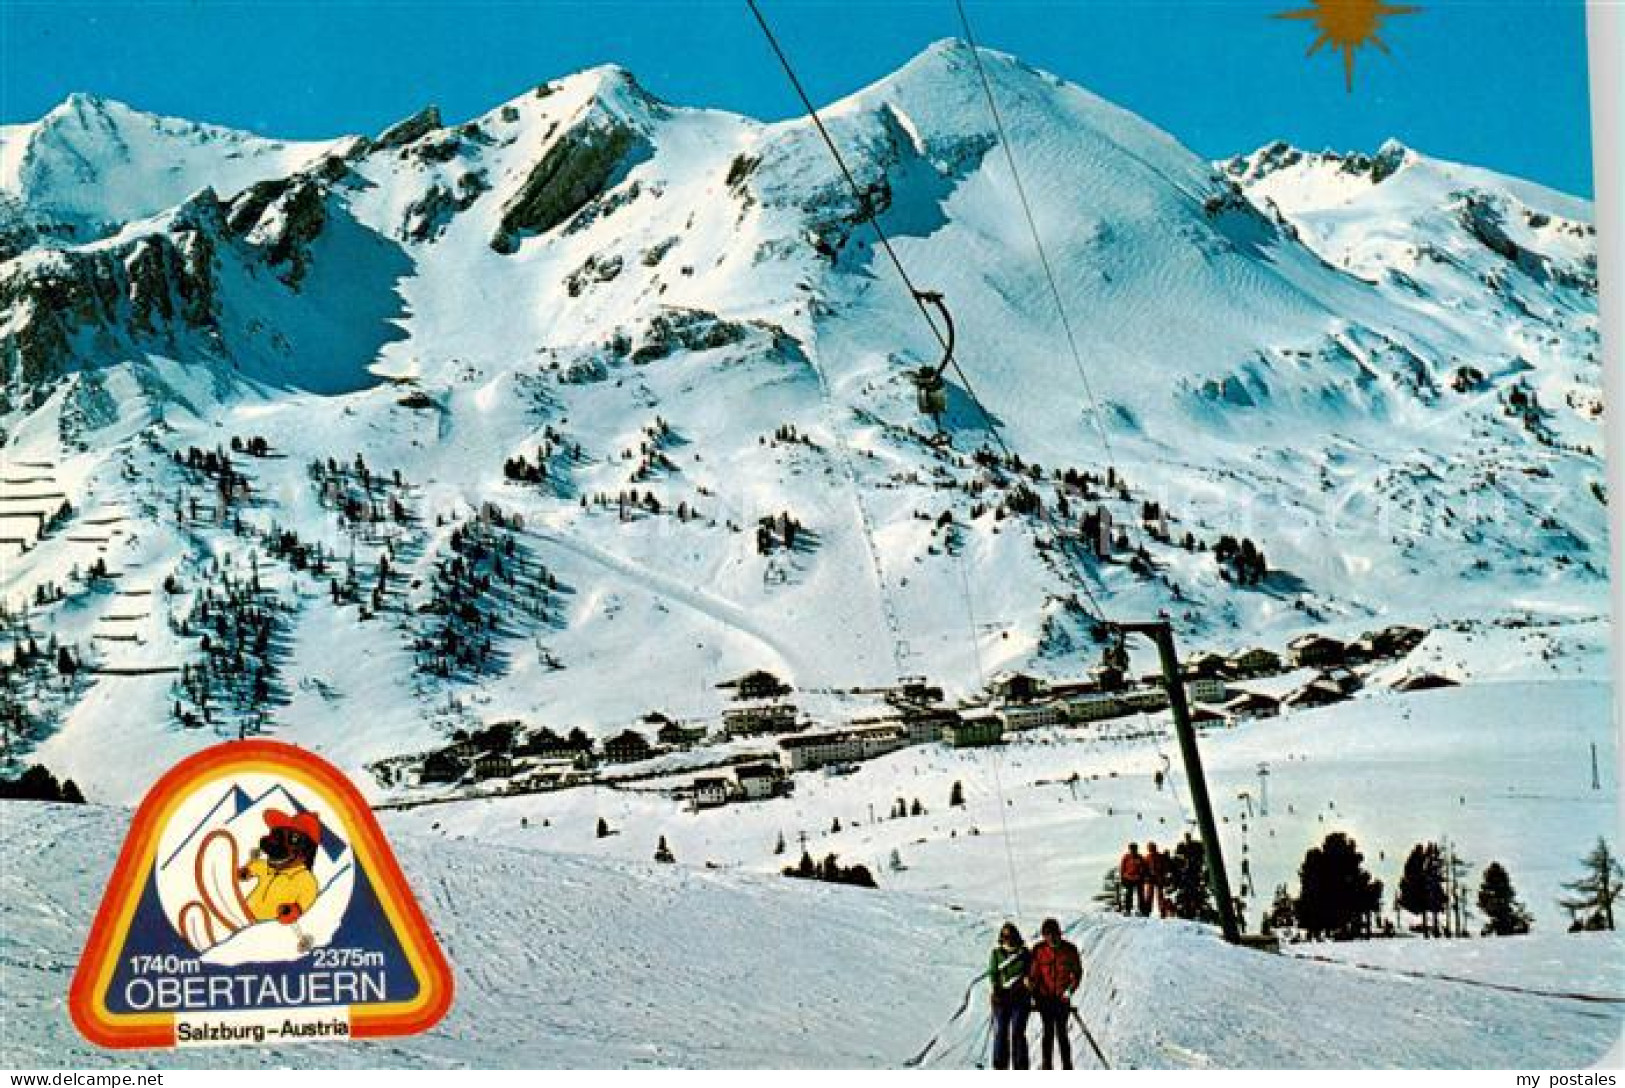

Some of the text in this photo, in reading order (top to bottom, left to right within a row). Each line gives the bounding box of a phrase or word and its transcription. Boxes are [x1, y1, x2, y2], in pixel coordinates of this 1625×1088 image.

[129, 953, 201, 975] 1740m
[312, 948, 385, 969] 2375m
[124, 969, 387, 1011] OBERTAUERN
